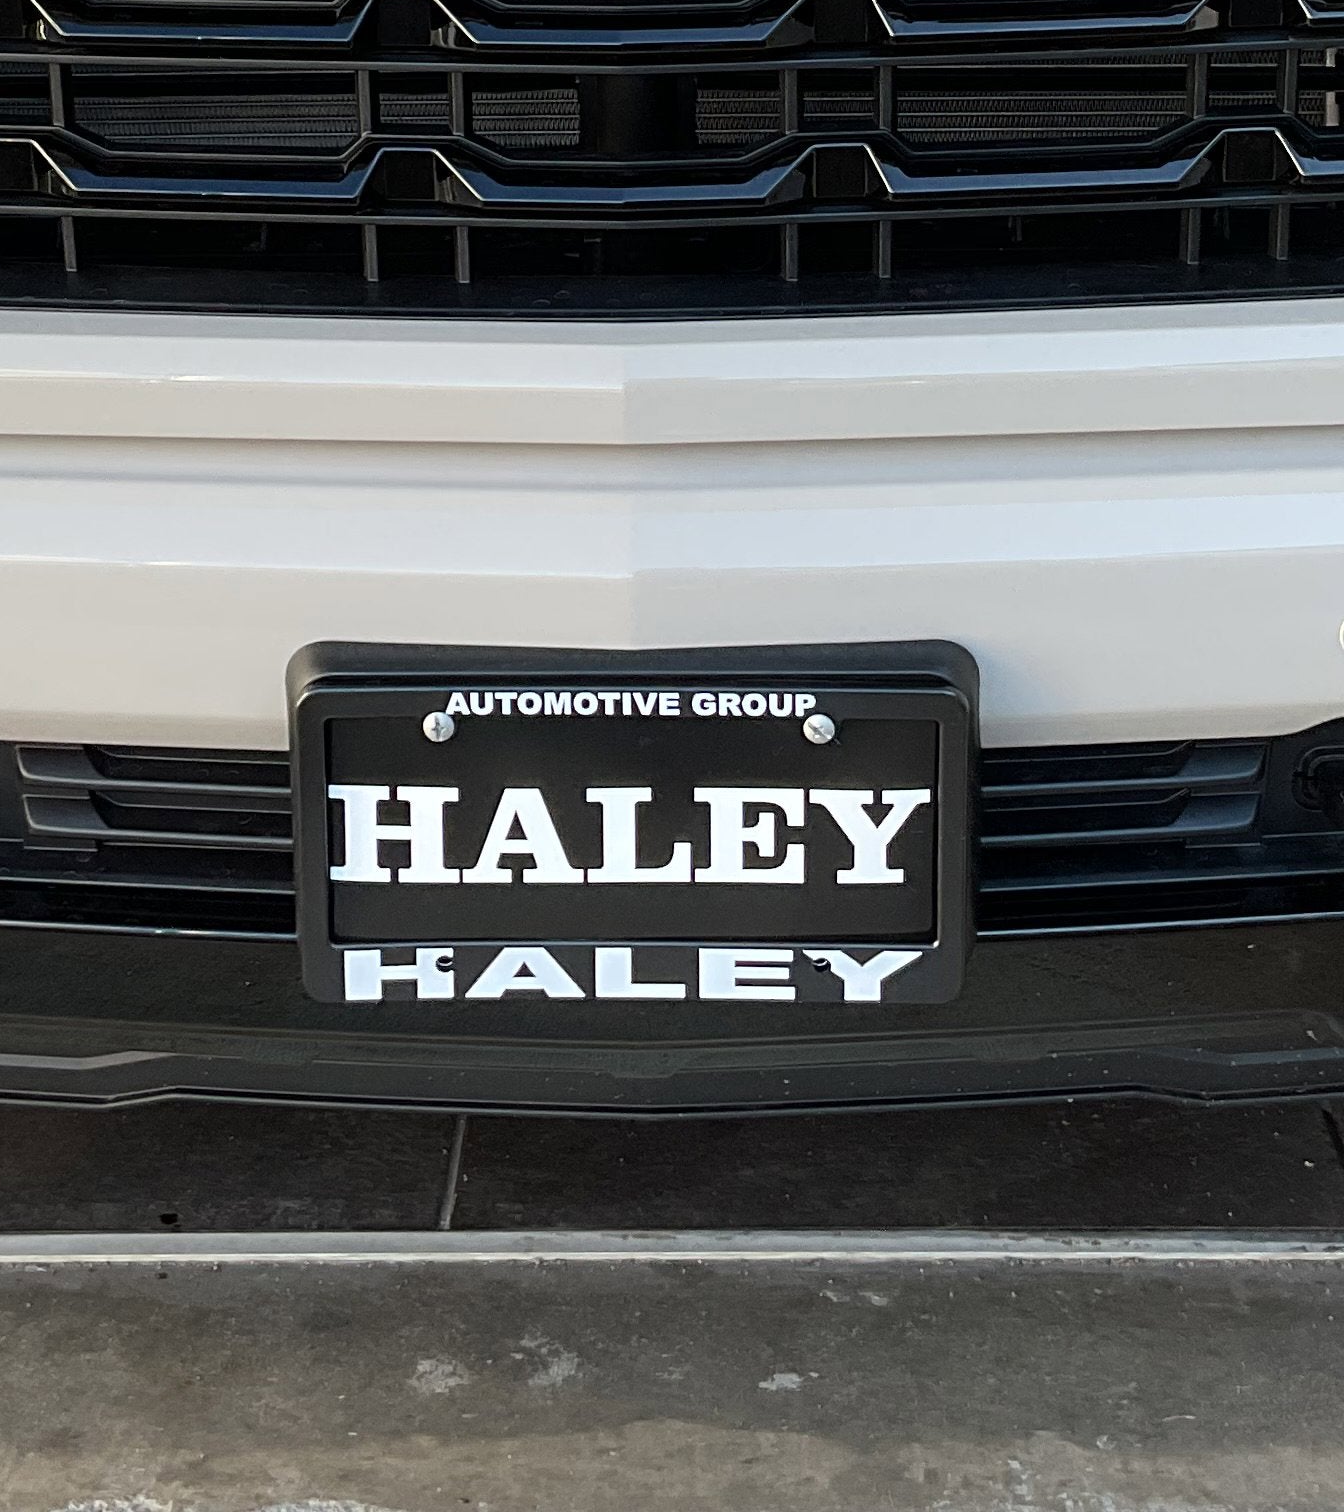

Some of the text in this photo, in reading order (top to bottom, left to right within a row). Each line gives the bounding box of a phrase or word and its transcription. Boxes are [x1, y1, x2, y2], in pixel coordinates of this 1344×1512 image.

[445, 691, 817, 718] AUTOMOTIVE GROUP
[328, 785, 932, 885] HALEY
[343, 946, 924, 1002] HALEY
